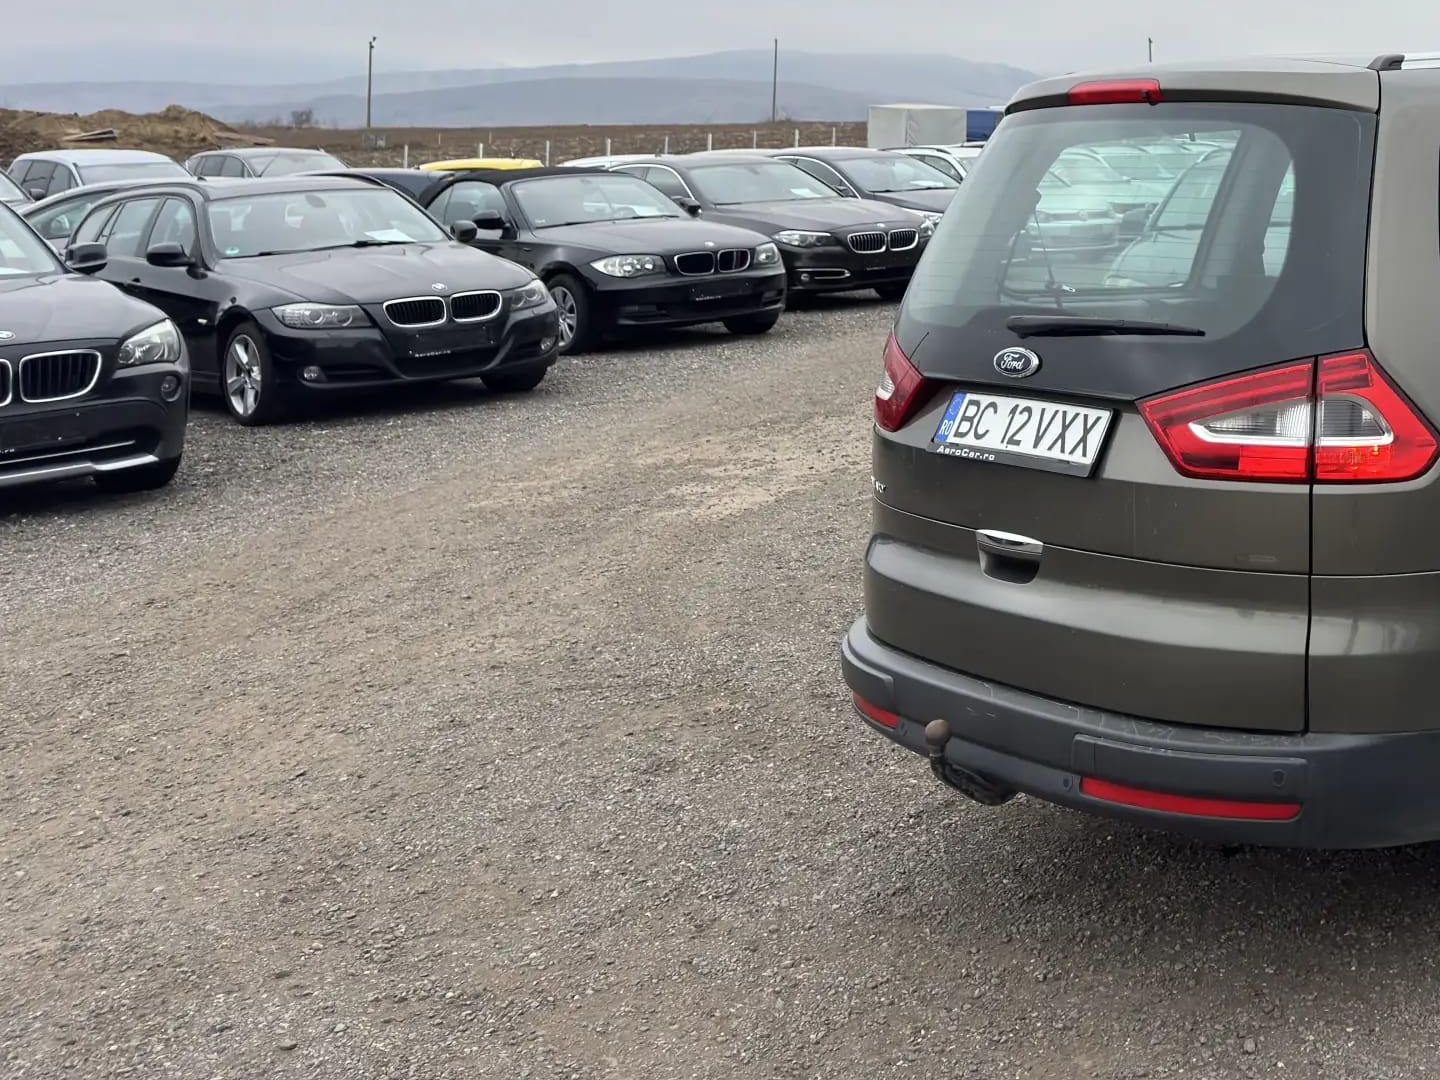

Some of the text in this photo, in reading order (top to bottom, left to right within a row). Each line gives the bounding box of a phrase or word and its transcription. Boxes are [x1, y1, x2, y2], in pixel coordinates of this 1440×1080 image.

[1001, 352, 1025, 370] Ford
[940, 419, 953, 435] RO
[953, 399, 1102, 458] BC 12 VXX
[936, 445, 996, 461] AeroCar.ro
